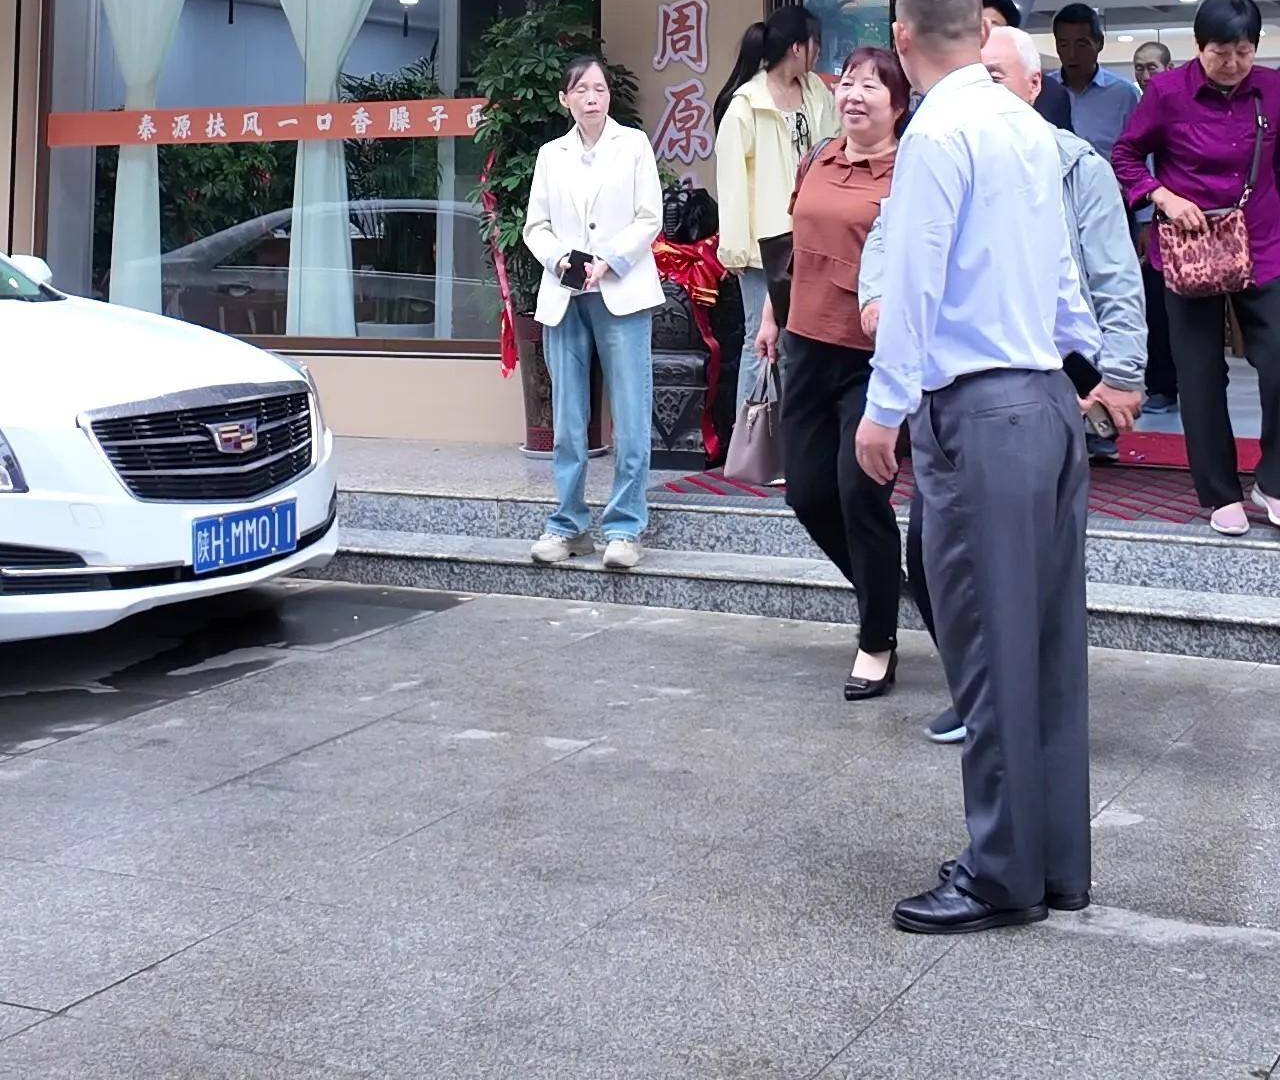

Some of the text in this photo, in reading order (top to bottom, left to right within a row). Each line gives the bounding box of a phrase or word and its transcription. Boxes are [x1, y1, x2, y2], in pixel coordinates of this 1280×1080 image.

[136, 104, 488, 142] 秦源扶风一口香臊子面
